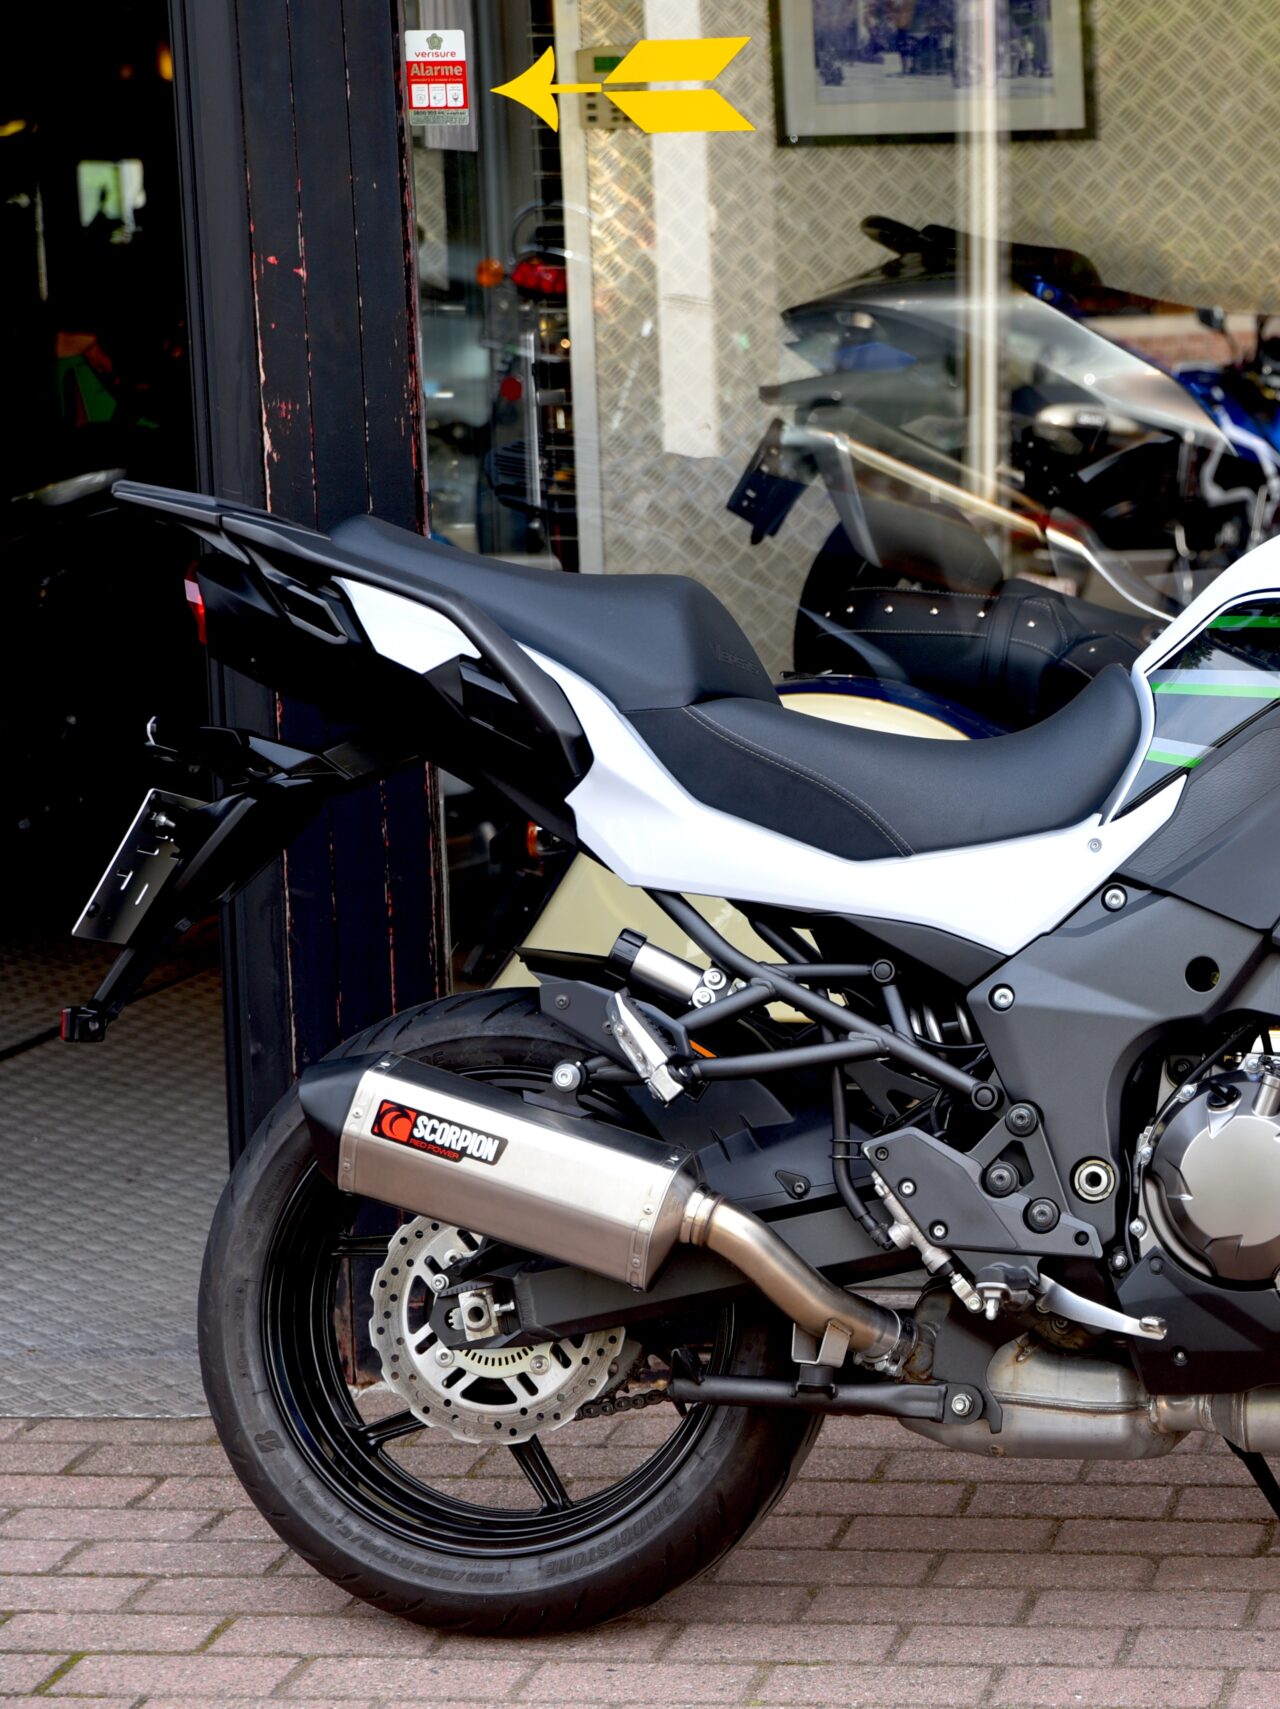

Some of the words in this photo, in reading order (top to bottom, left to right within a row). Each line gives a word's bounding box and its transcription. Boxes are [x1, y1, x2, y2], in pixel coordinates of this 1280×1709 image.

[414, 50, 456, 58] verisure
[410, 62, 463, 76] Alarme
[409, 1138, 427, 1149] RED
[427, 1143, 460, 1159] POWER
[413, 1115, 499, 1162] SCORPION
[545, 1489, 681, 1579] BRIDGESTONE
